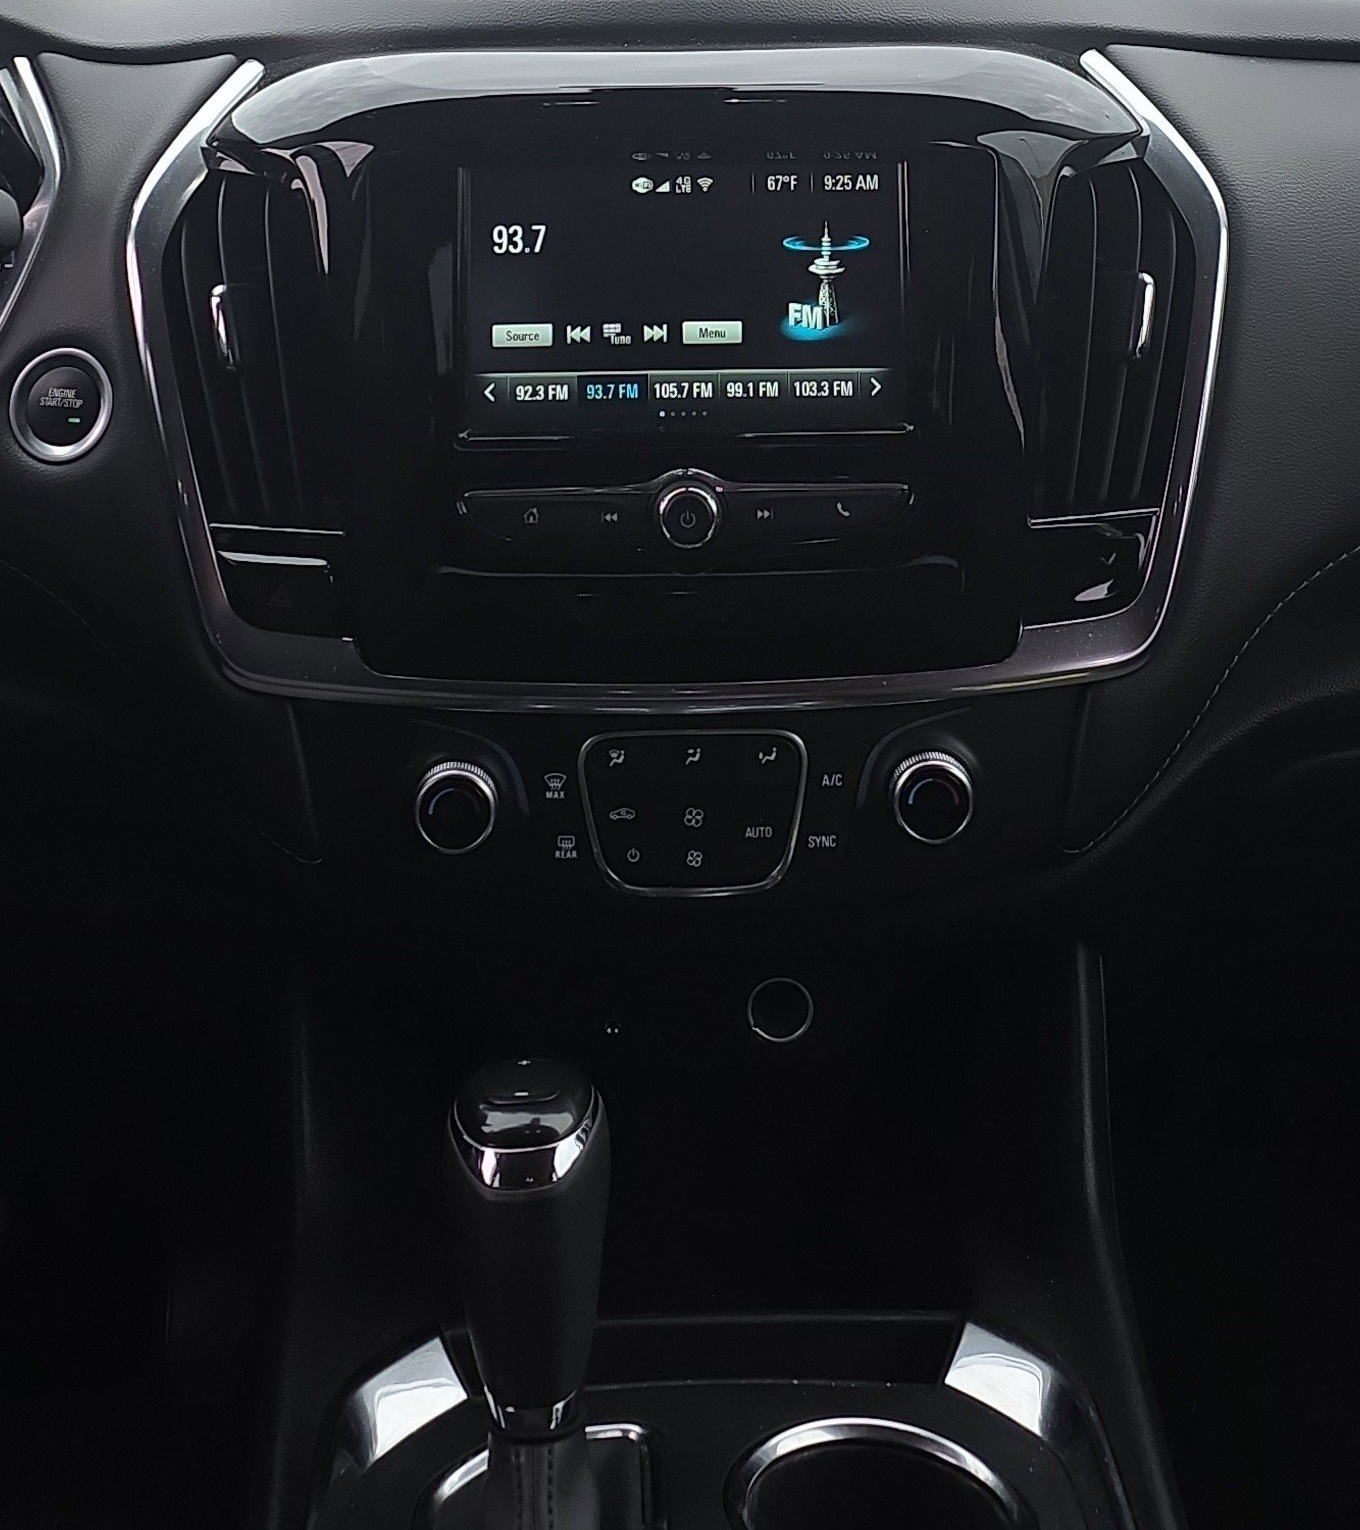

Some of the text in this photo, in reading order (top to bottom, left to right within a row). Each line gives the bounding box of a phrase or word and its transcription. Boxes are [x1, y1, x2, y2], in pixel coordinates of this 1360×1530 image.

[766, 174, 798, 191] 67°F
[823, 174, 879, 191] 9:25 AM
[491, 223, 548, 255] 93.7
[787, 302, 825, 331] FM
[505, 329, 540, 343] Source
[698, 326, 727, 340] Menu
[515, 385, 569, 402] 92.3 FM
[586, 383, 639, 400] 93.7 FM
[653, 382, 713, 399] 105.7 FM
[726, 381, 779, 399] 99.1 FM
[793, 380, 854, 398] 103.3 FM
[822, 773, 843, 787] A/C
[545, 791, 566, 800] MAX
[745, 826, 774, 839] AUTO
[808, 834, 838, 849] SYNC
[555, 849, 578, 860] REAR
